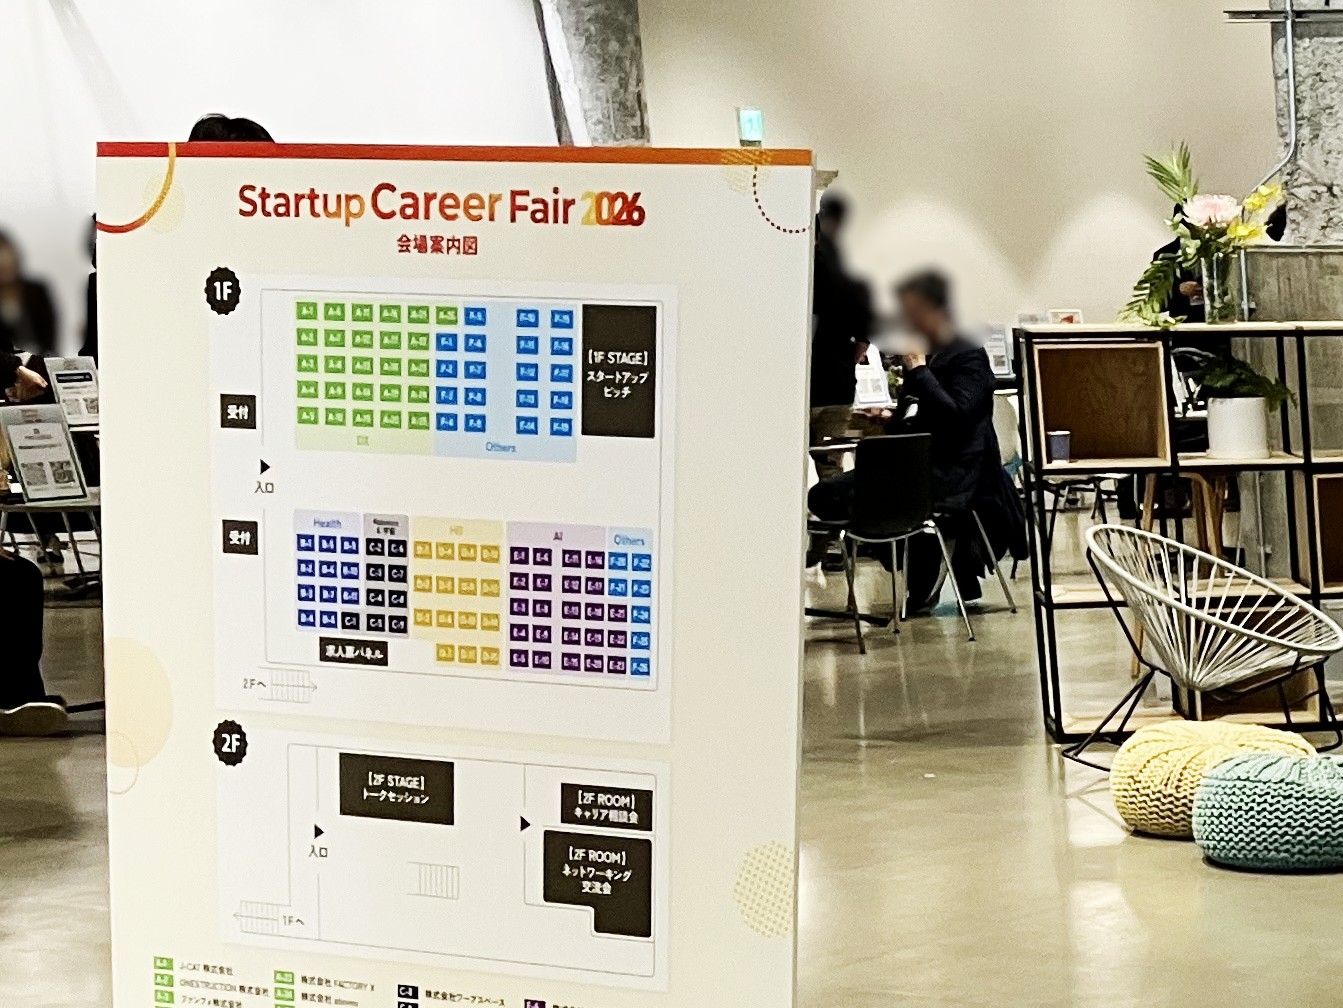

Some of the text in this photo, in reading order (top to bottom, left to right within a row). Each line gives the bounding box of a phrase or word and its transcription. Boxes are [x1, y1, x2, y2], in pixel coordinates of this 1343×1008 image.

[239, 183, 646, 227] Startup Career Fair 2026
[397, 234, 478, 255] 会場案内図
[214, 282, 232, 300] 1F
[587, 371, 649, 384] スタートアップ
[227, 404, 248, 420] 受付
[486, 442, 516, 452] Others
[254, 481, 274, 494] 入口
[229, 530, 250, 545] 受付
[614, 534, 645, 546] Others
[222, 734, 240, 752] 2F
[364, 788, 429, 804] トークセッション
[309, 845, 328, 858] 入口
[562, 864, 632, 882] ネットワーキング
